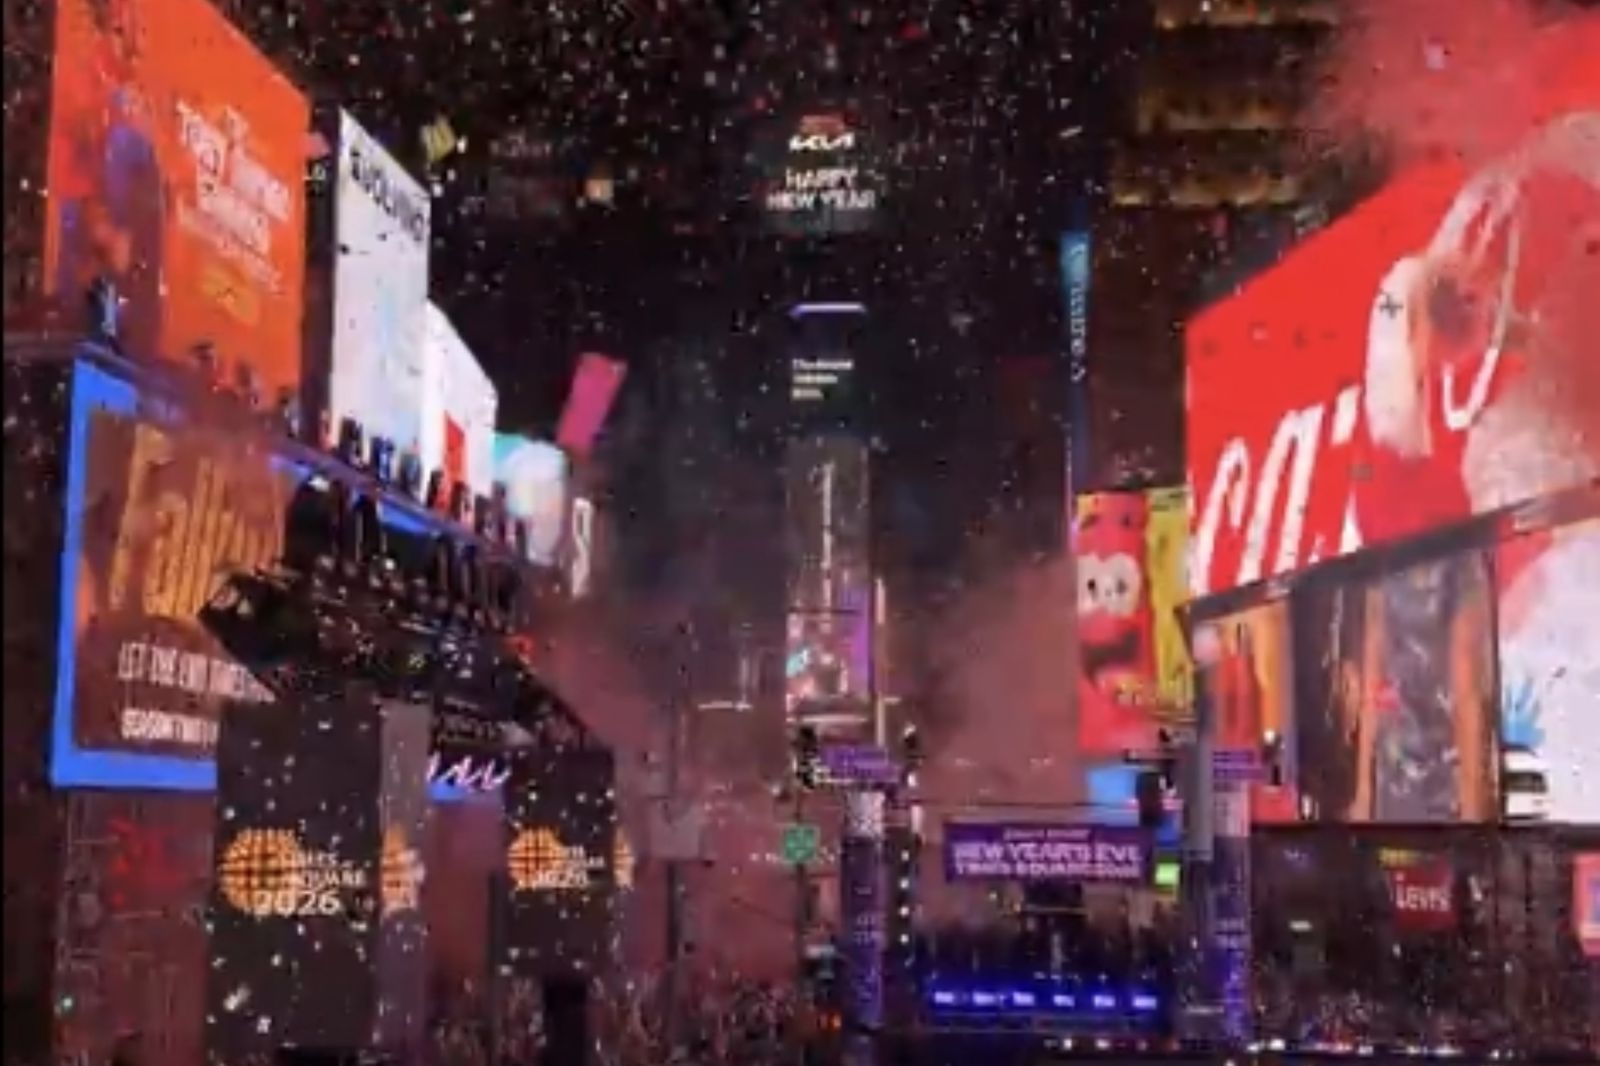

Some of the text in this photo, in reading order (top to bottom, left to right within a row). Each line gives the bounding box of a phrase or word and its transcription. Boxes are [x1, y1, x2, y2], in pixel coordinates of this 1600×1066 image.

[786, 165, 858, 190] HAPPY
[766, 188, 875, 210] NEW YEAR
[955, 842, 1003, 861] NEW
[254, 889, 341, 917] 2026
